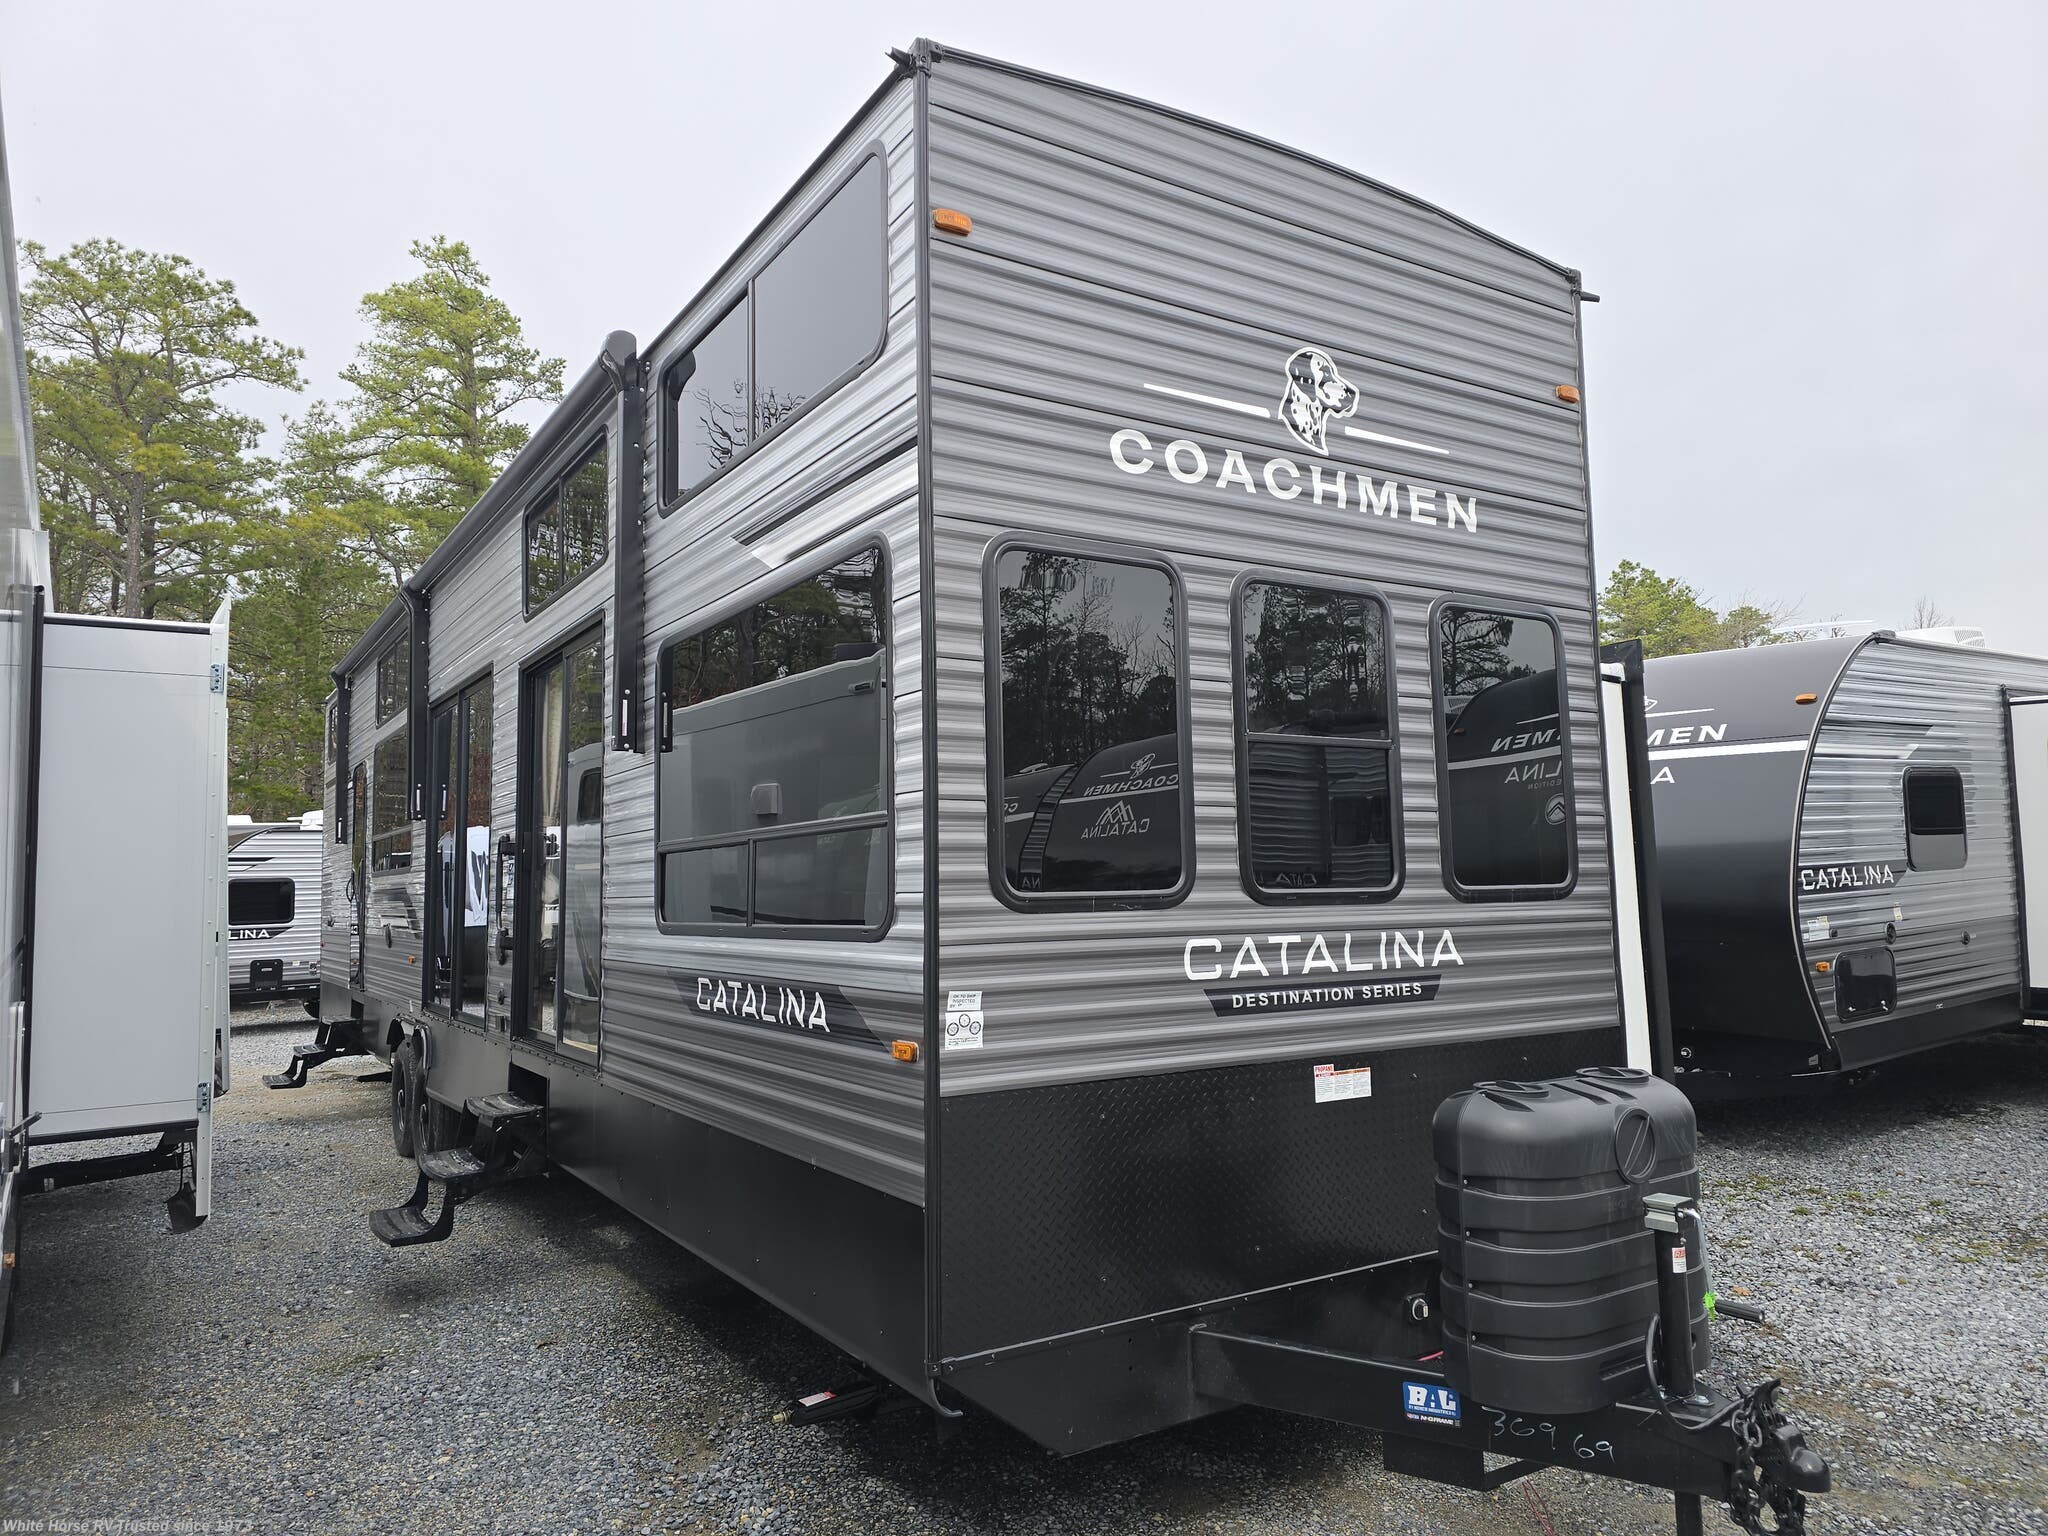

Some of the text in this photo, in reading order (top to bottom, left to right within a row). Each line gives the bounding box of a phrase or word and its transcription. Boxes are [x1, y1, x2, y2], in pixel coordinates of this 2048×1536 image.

[1109, 428, 1479, 533] COACHMEN
[1801, 864, 1894, 890] CATALINA
[1183, 929, 1464, 980] CATALINA
[697, 977, 830, 1032] CATALINA
[1232, 982, 1423, 1008] DESTINATION SERIES
[1407, 1385, 1457, 1411] BAL
